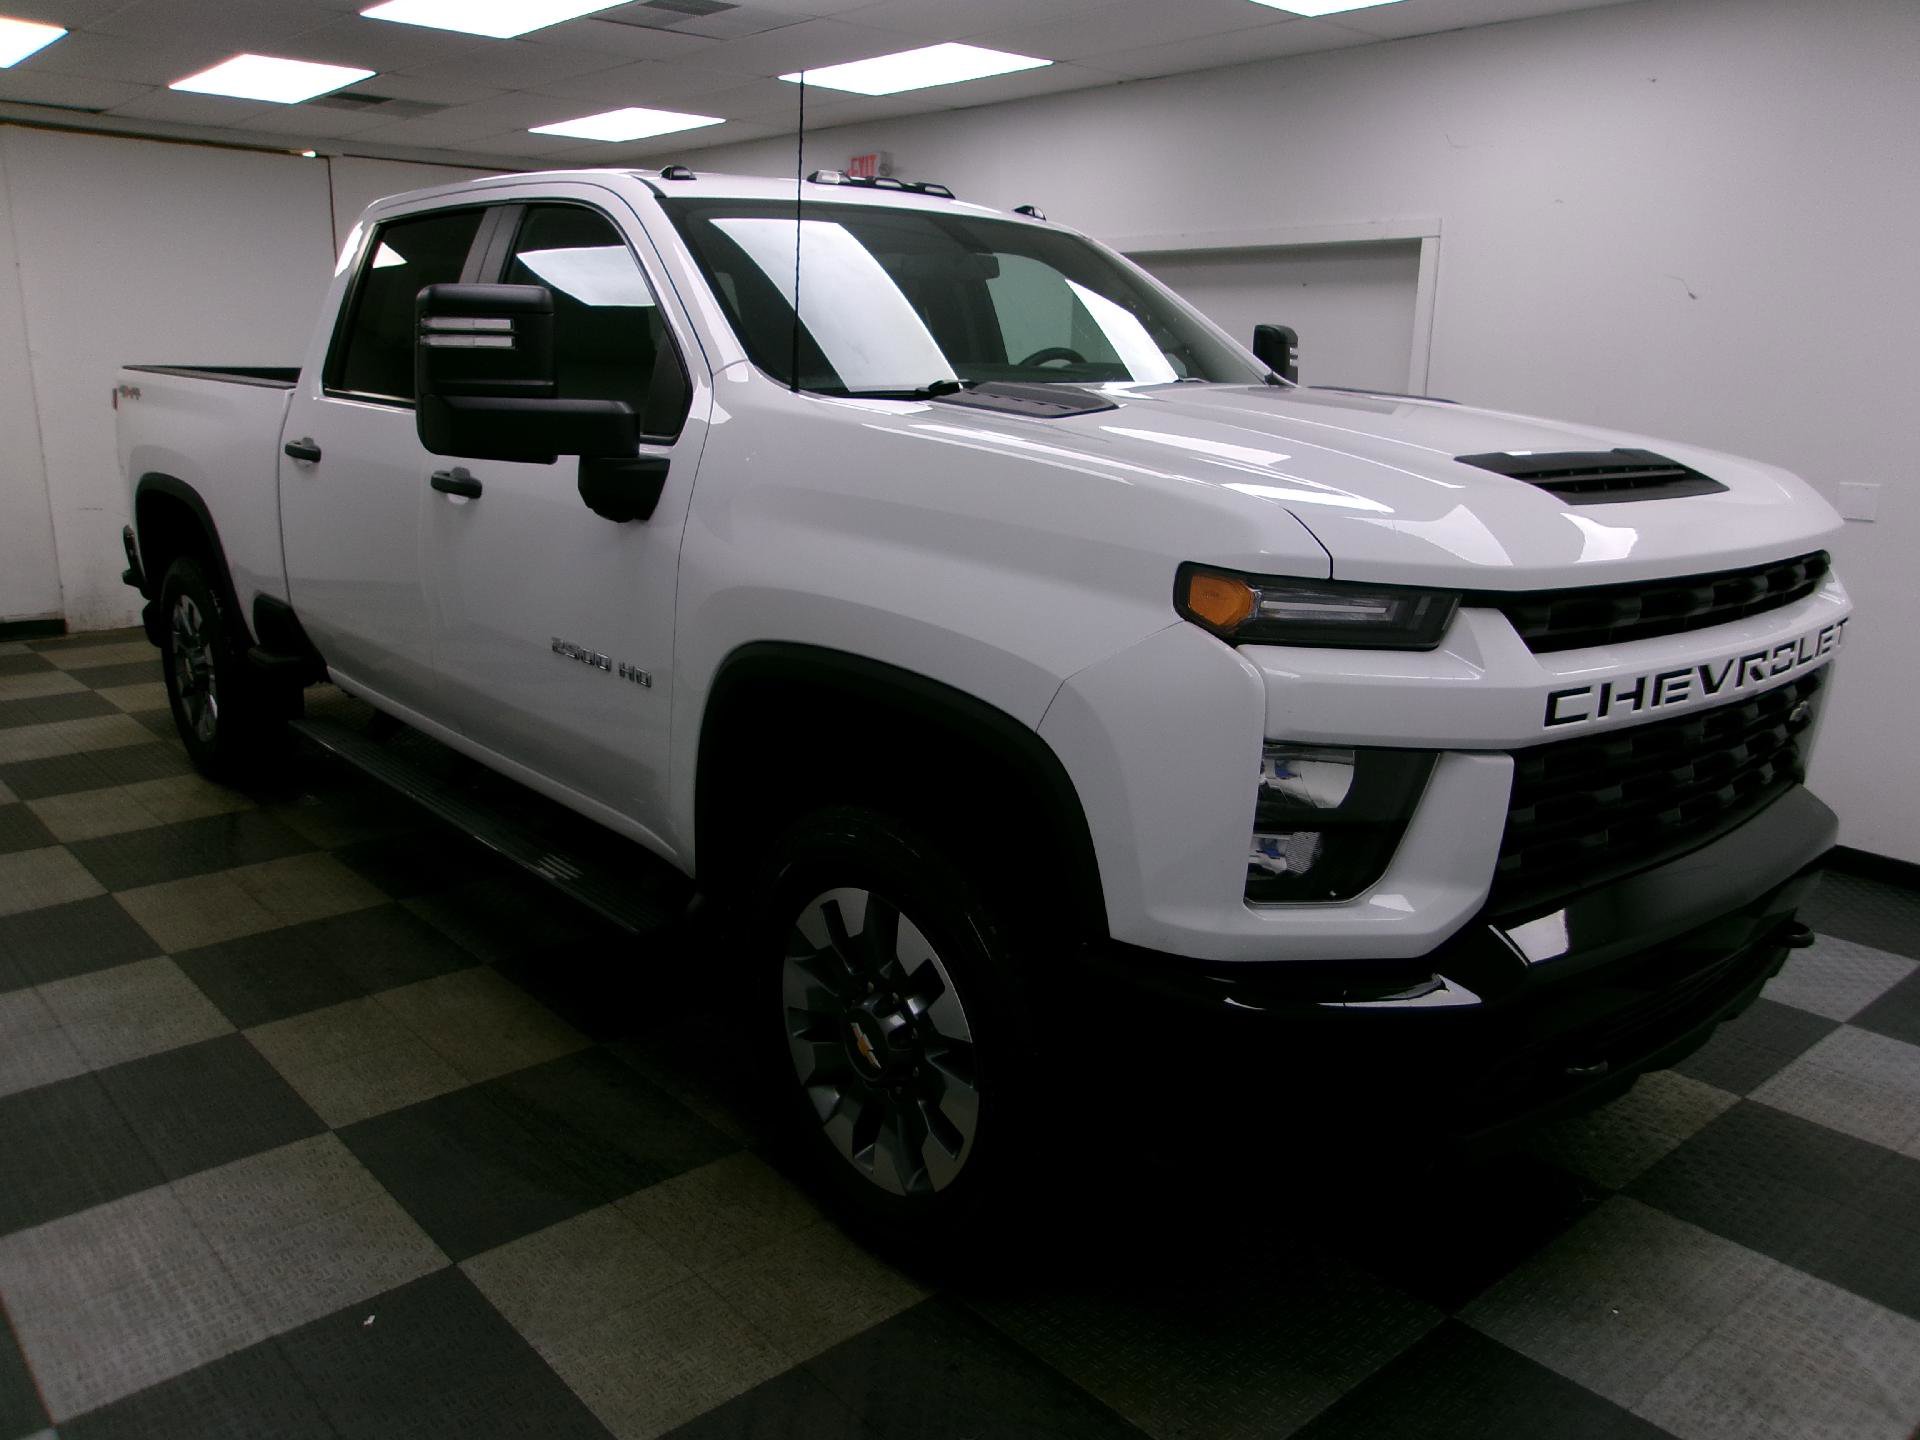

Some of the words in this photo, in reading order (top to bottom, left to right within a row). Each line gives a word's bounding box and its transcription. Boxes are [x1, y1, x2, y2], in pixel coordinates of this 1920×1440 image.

[848, 154, 876, 176] EXIT
[552, 636, 612, 673] 2500
[618, 661, 653, 689] HD
[1543, 617, 1850, 728] CHEVROLET
